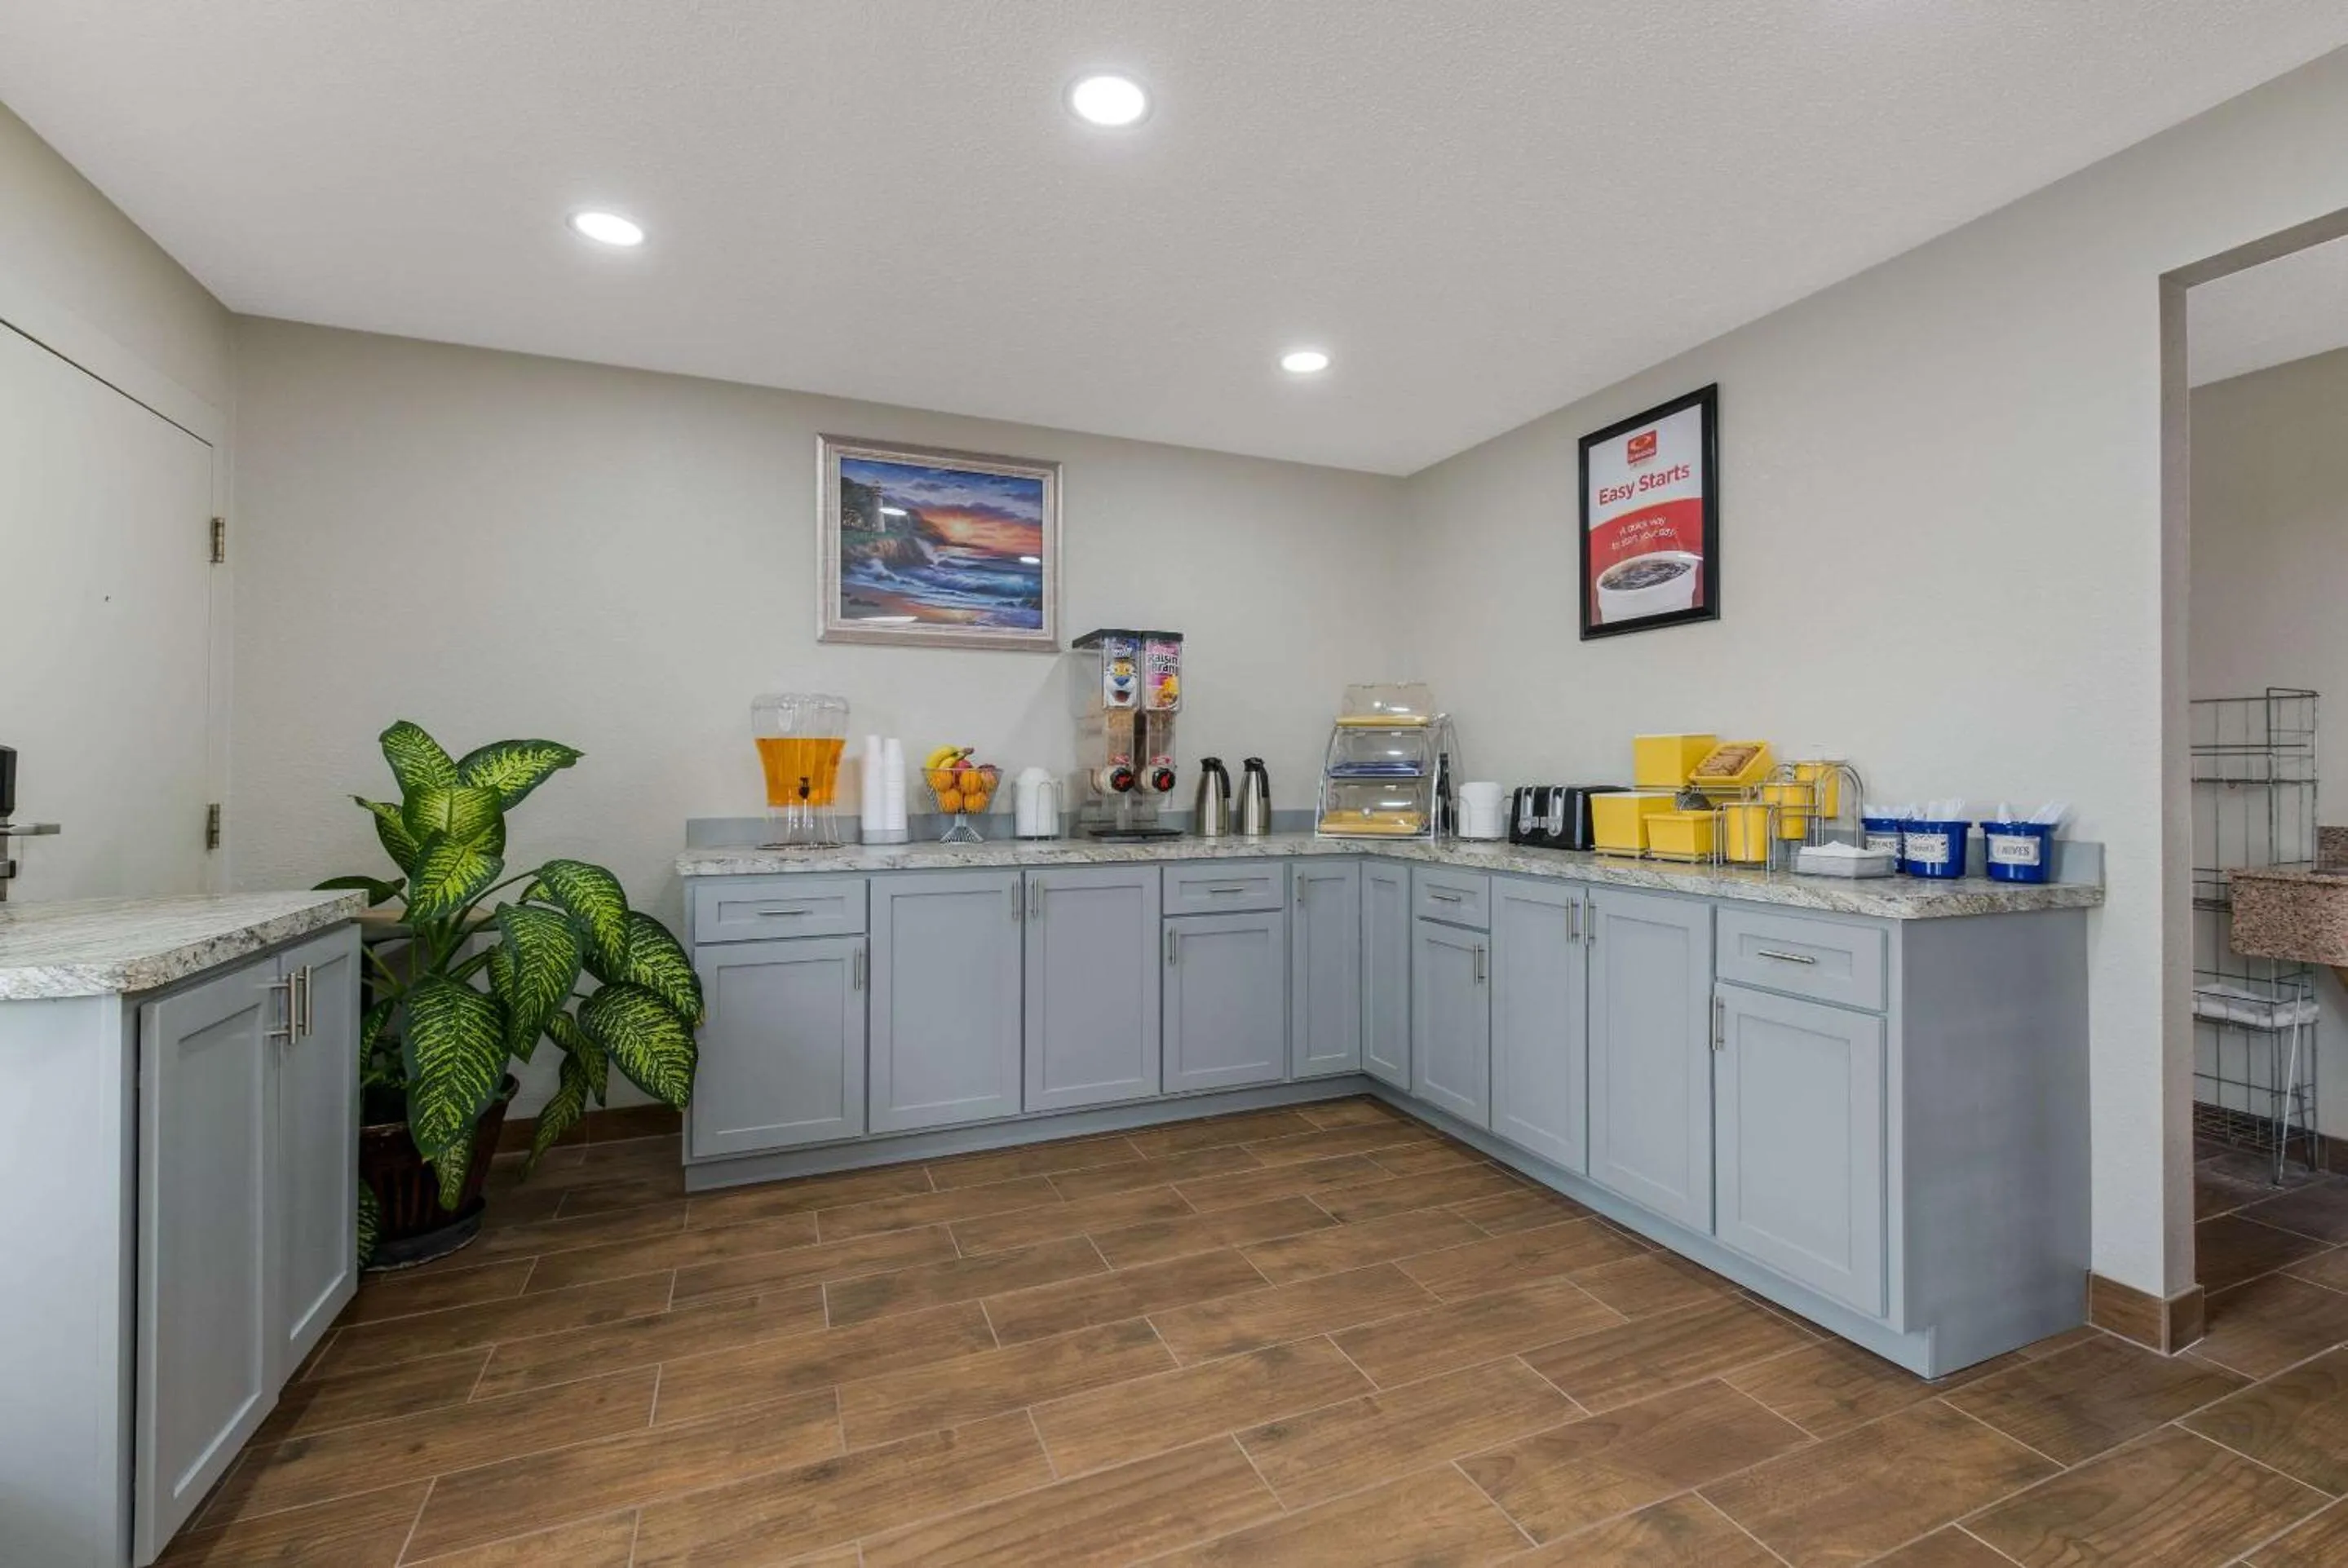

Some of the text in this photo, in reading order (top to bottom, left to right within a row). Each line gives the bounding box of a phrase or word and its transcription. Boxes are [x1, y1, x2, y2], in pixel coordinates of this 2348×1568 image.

[1599, 463, 1691, 506] Easy Starts
[1147, 653, 1178, 665] Raisin
